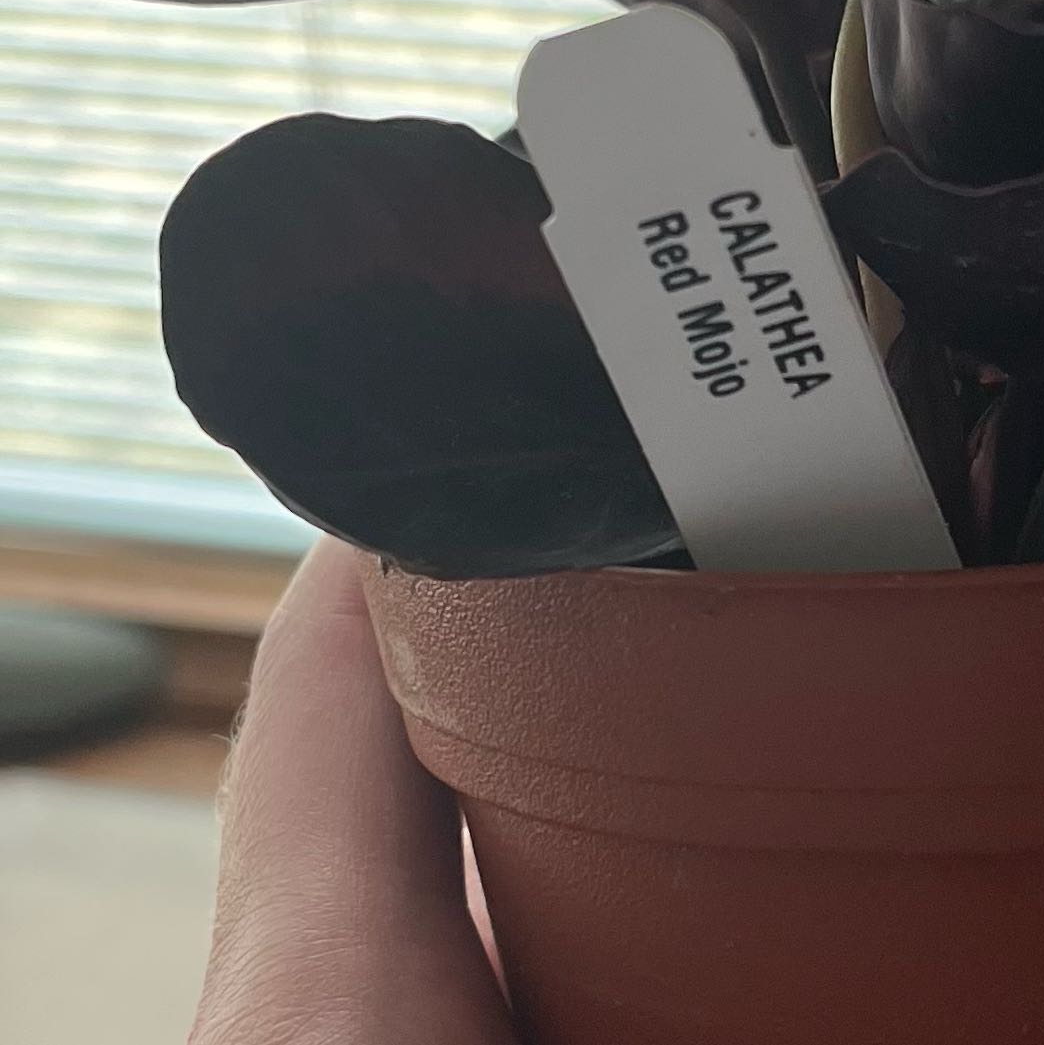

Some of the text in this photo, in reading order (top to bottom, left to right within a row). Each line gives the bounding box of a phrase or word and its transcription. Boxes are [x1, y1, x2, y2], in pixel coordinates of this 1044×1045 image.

[637, 210, 749, 398] Red Mojo
[709, 190, 832, 399] CALATHEA
